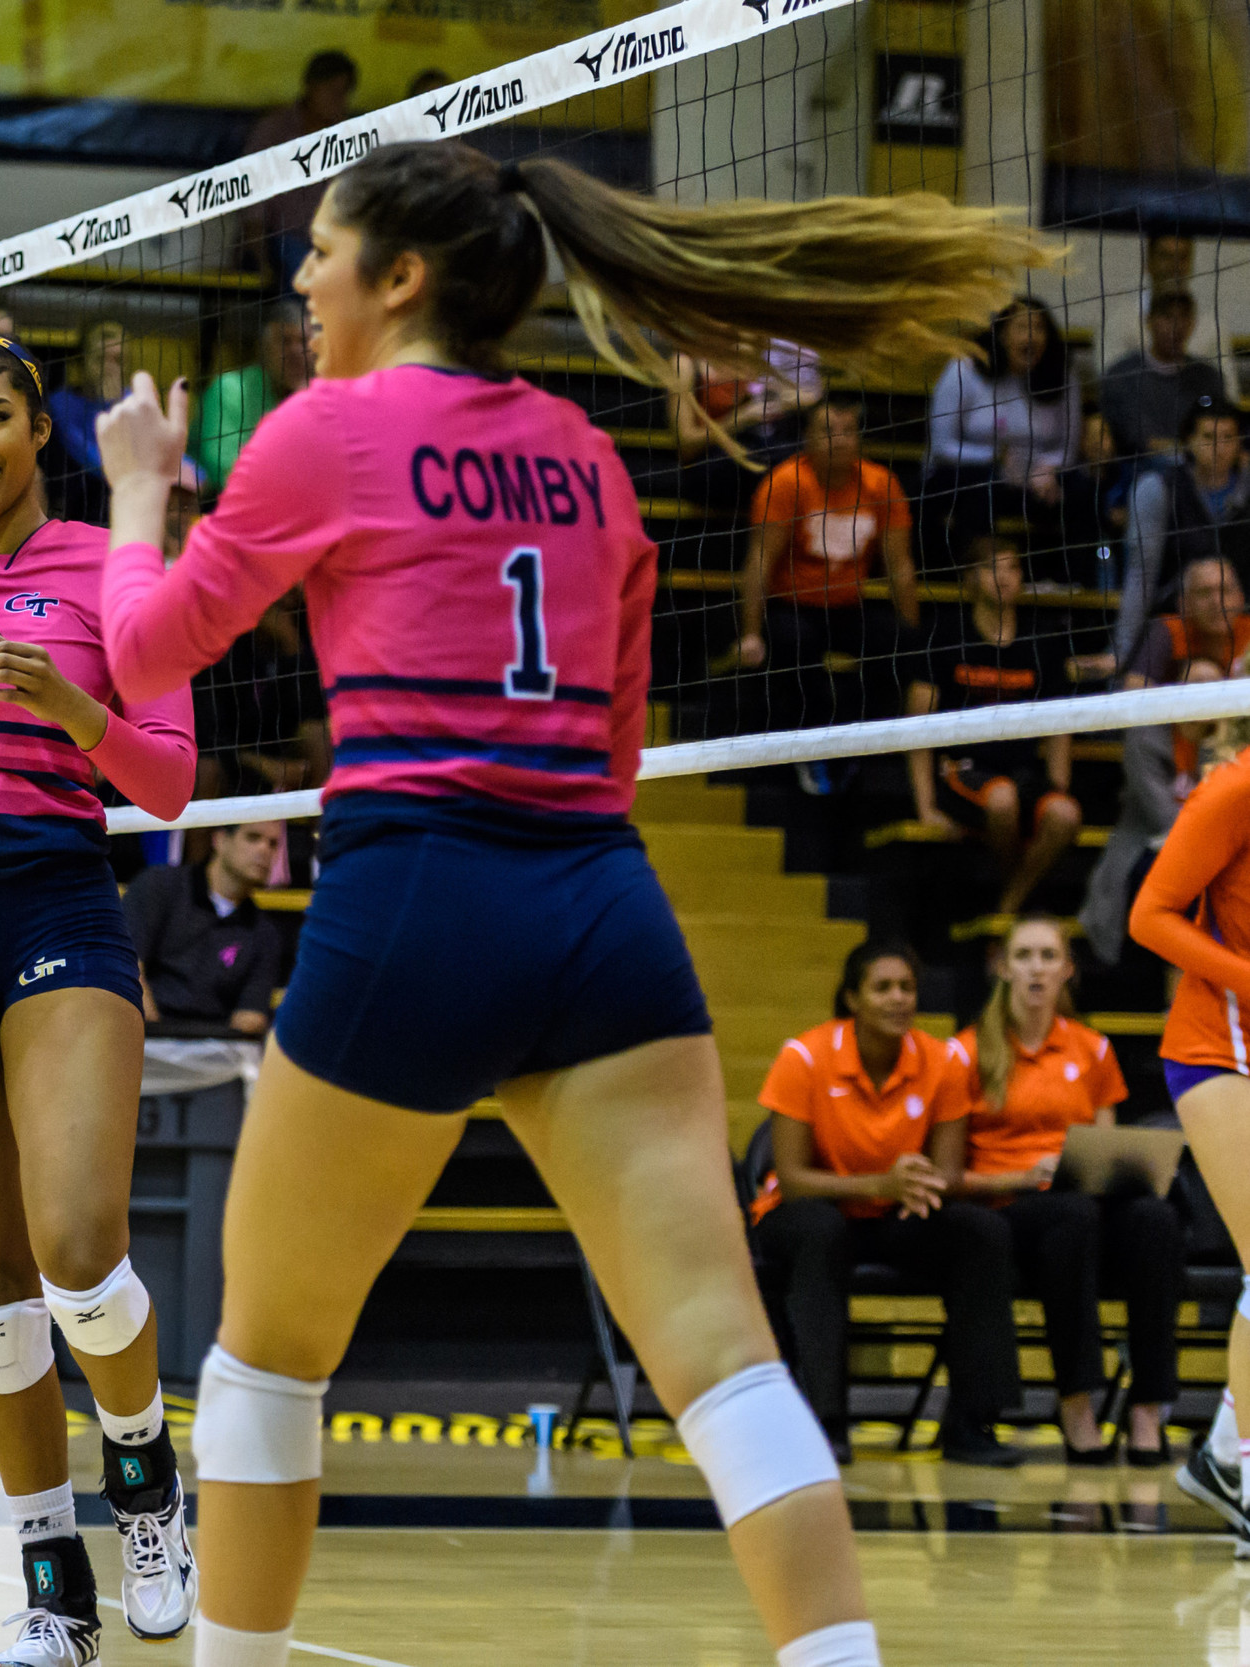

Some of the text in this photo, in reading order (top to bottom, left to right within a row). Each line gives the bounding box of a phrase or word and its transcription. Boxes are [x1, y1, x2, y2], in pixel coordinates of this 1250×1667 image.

[411, 445, 606, 530] COMBY
[4, 591, 60, 619] GT
[501, 545, 557, 701] 1
